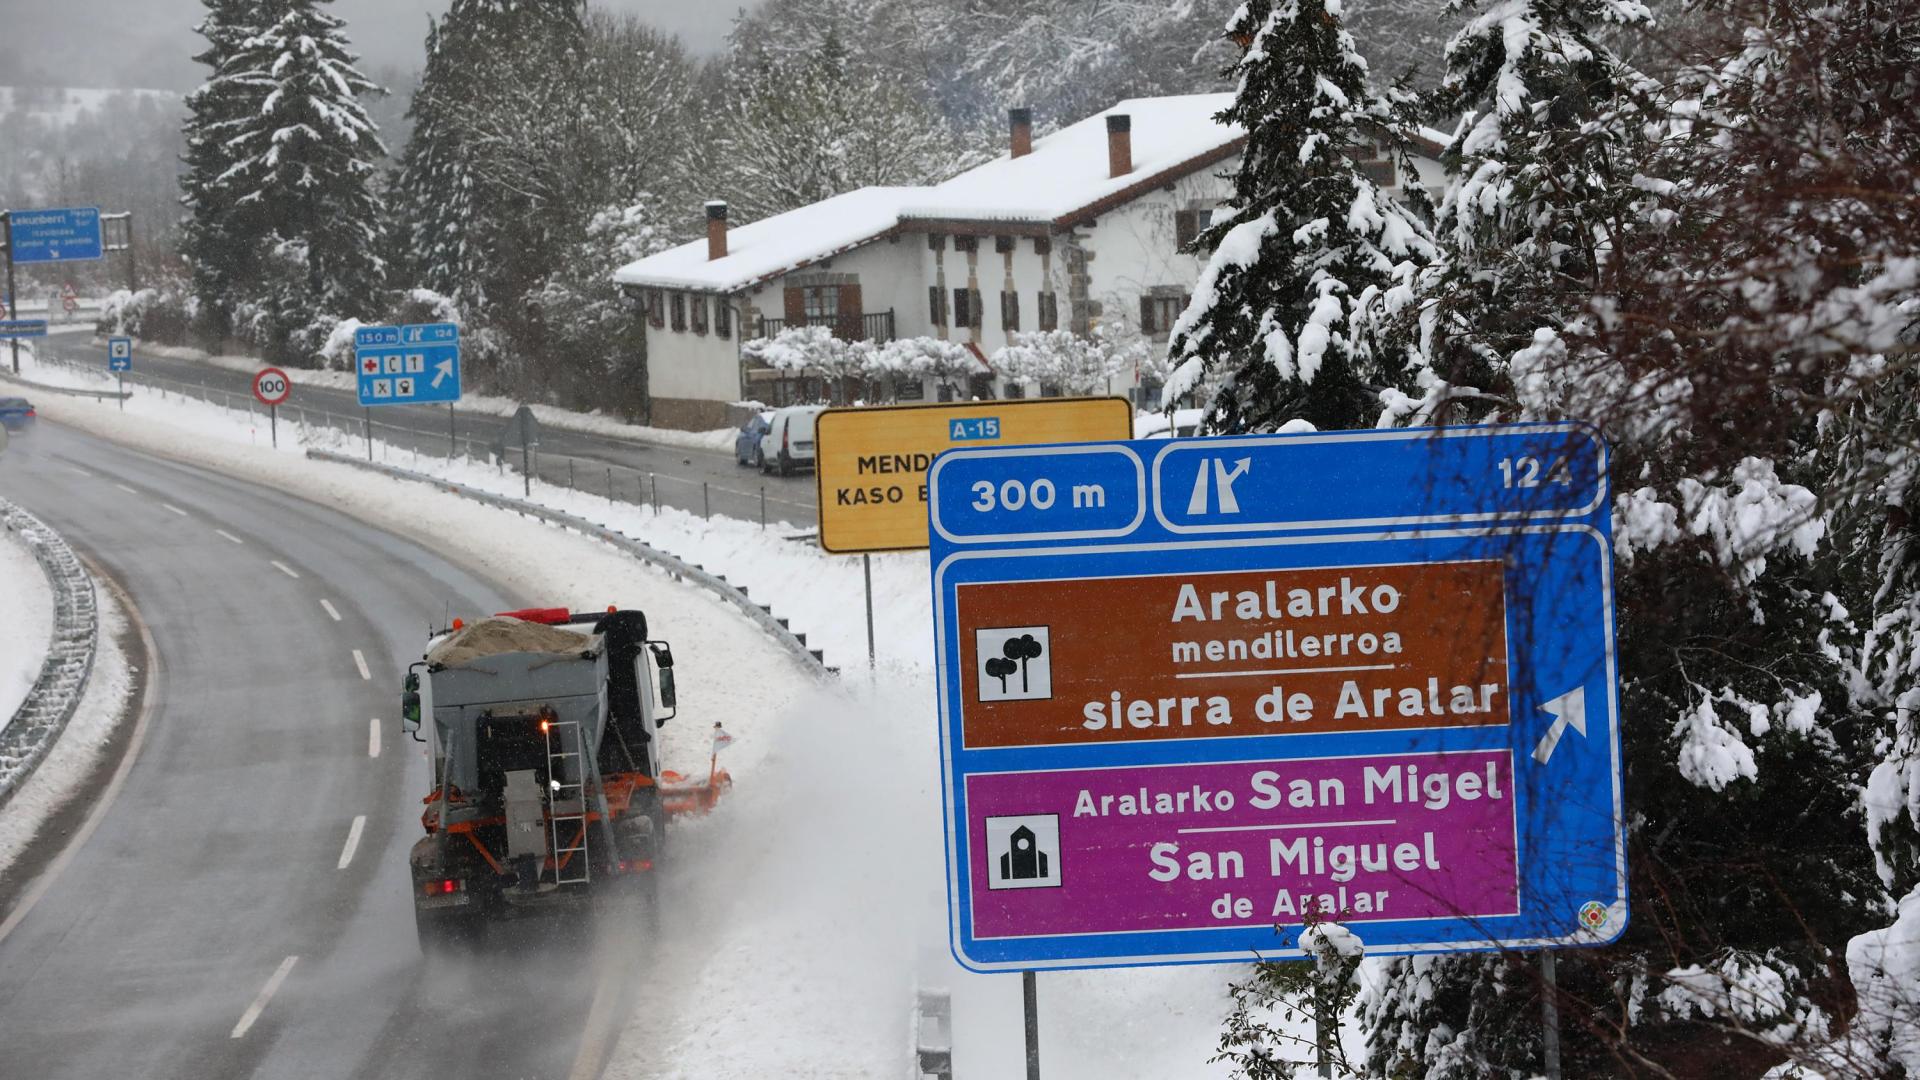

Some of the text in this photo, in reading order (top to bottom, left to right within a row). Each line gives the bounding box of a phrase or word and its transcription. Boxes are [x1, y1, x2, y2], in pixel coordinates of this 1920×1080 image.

[360, 332, 397, 343] 150 m
[259, 379, 285, 394] 100
[952, 420, 998, 439] A-15
[1498, 456, 1572, 488] 124
[837, 484, 904, 506] KASO
[970, 478, 1105, 512] 300 m
[1171, 577, 1402, 623] Aralarko
[1171, 629, 1403, 663] mendilerroa
[1082, 677, 1500, 731] sierra de Aralar
[1073, 761, 1503, 818] Aralarko San Migel
[1148, 832, 1441, 883] San Miguel
[1211, 893, 1254, 920] de
